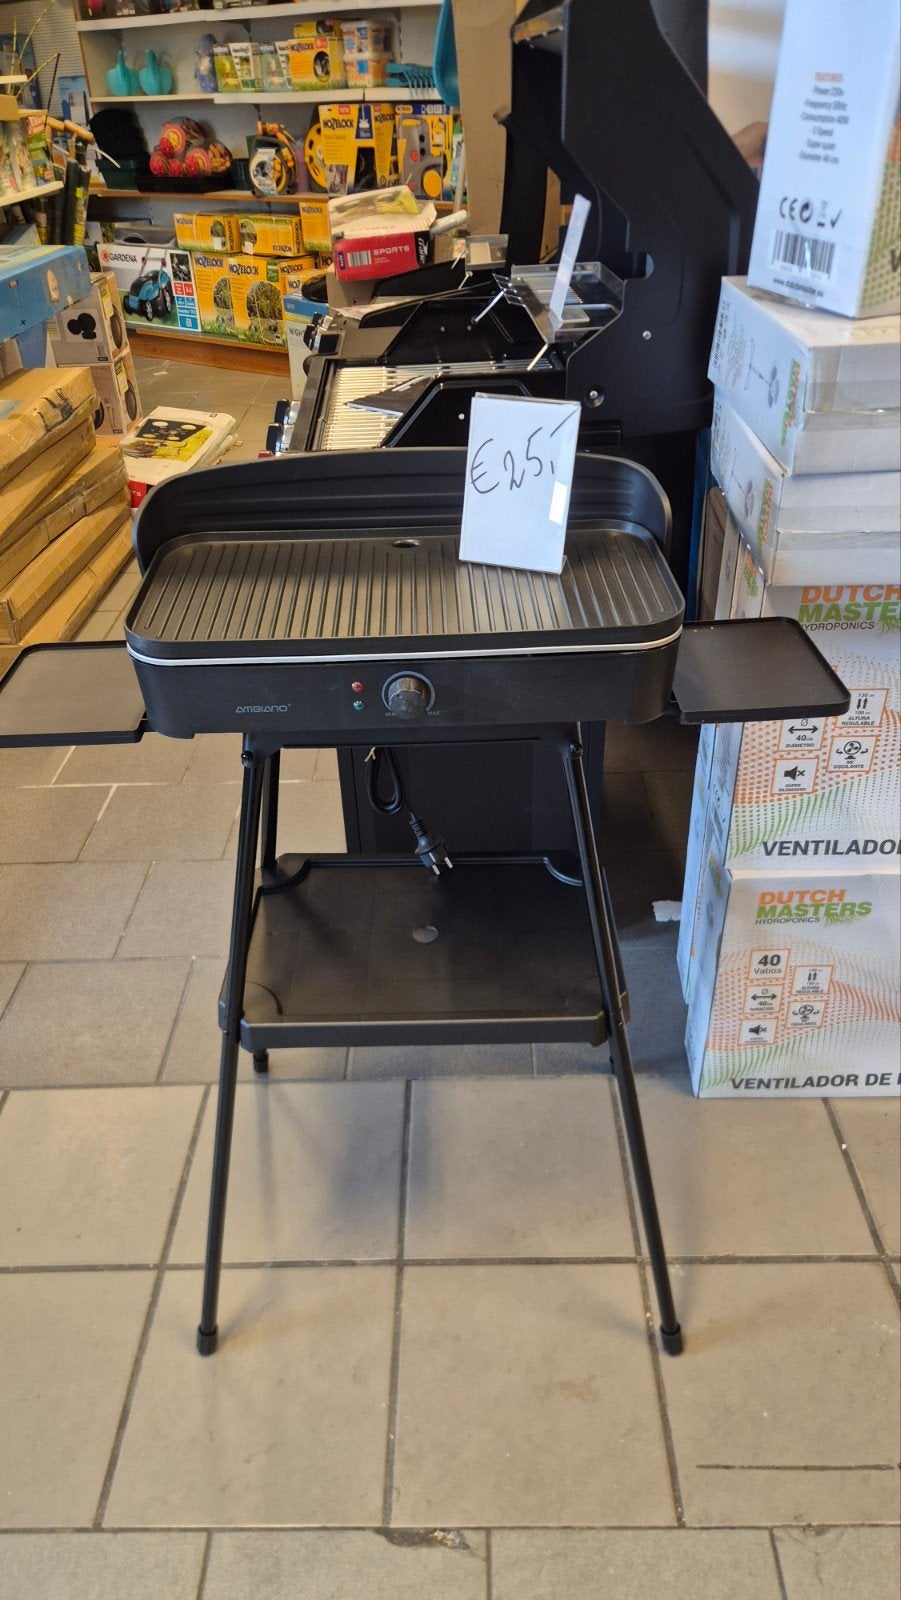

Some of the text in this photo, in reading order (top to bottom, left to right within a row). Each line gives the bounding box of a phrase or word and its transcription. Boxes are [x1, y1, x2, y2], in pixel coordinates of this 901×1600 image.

[322, 118, 354, 130] HOZELOCK
[373, 245, 410, 256] SPORTS
[109, 251, 138, 263] GARDENA
[194, 256, 224, 268] HOZELOCK
[228, 264, 259, 275] HOZELOCK
[801, 585, 901, 604] DUTCH
[800, 621, 876, 632] YDROPONICS
[759, 888, 846, 906] DUTCH
[756, 901, 873, 919] MASTERS
[754, 916, 820, 925] HYDROPONICS
[757, 954, 781, 967] 40
[731, 1074, 859, 1090] VENTILADOR
[864, 1072, 892, 1087] DE
